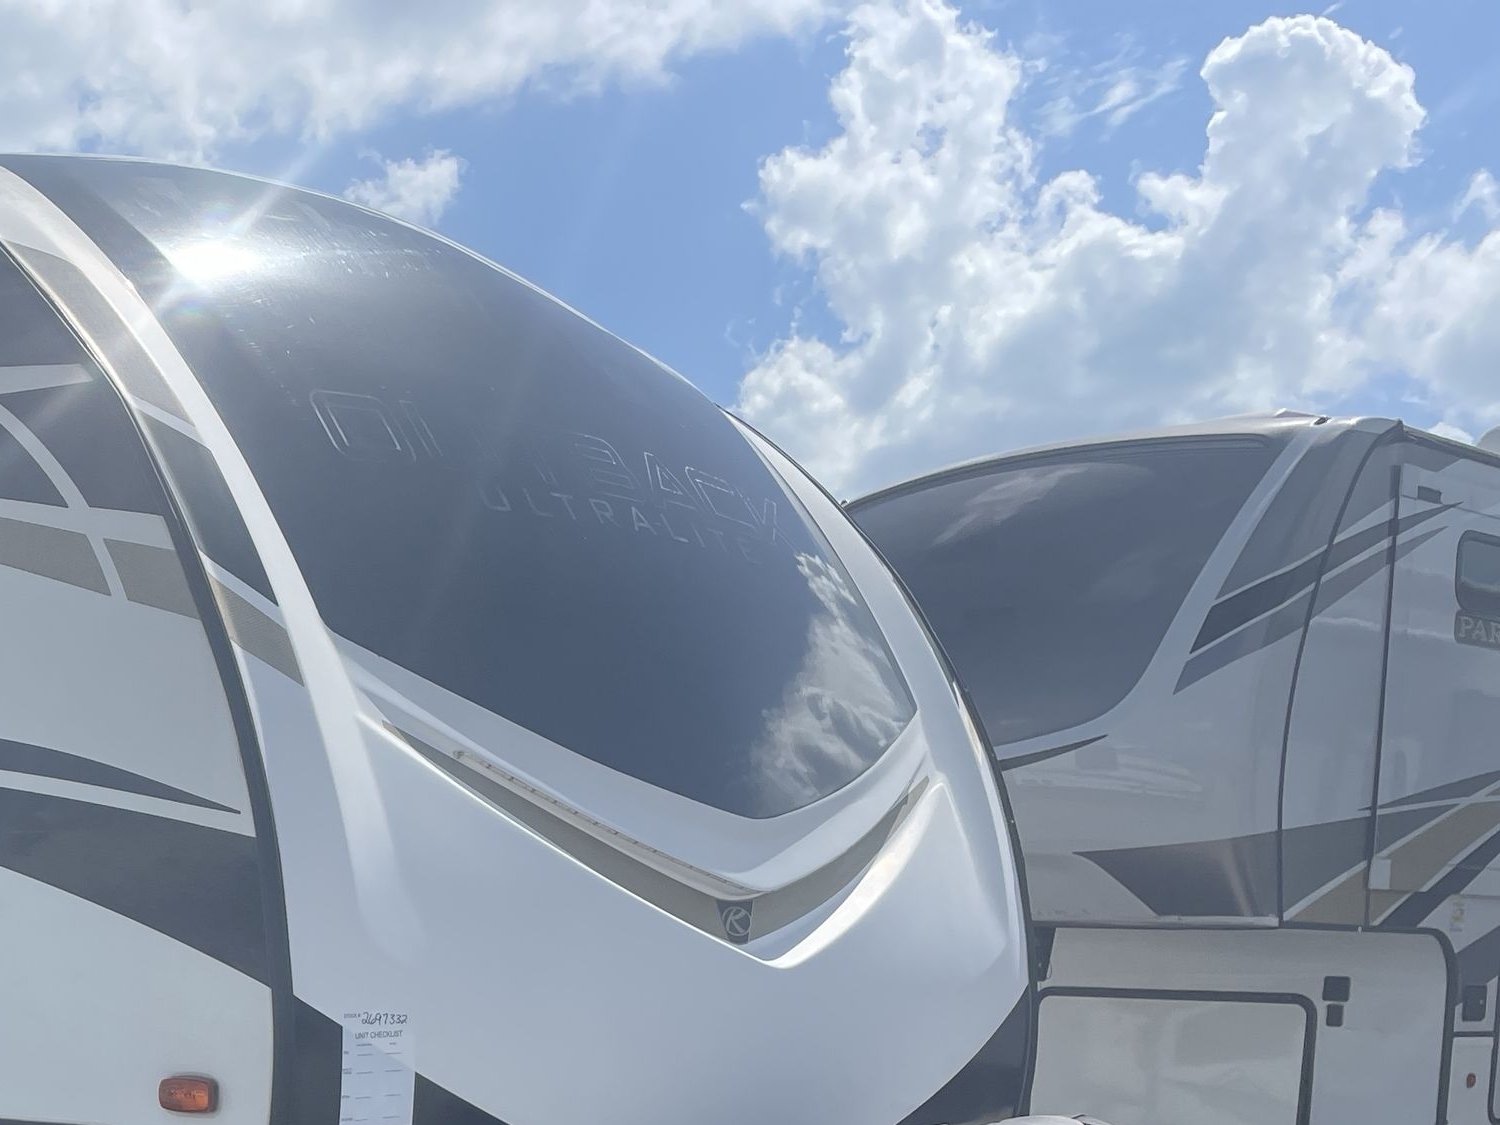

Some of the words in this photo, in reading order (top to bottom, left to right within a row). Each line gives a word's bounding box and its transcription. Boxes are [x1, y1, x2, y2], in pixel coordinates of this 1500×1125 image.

[361, 1011, 408, 1026] 2697332
[355, 1031, 369, 1039] UNIT
[370, 1029, 403, 1039] CHECKLIST
